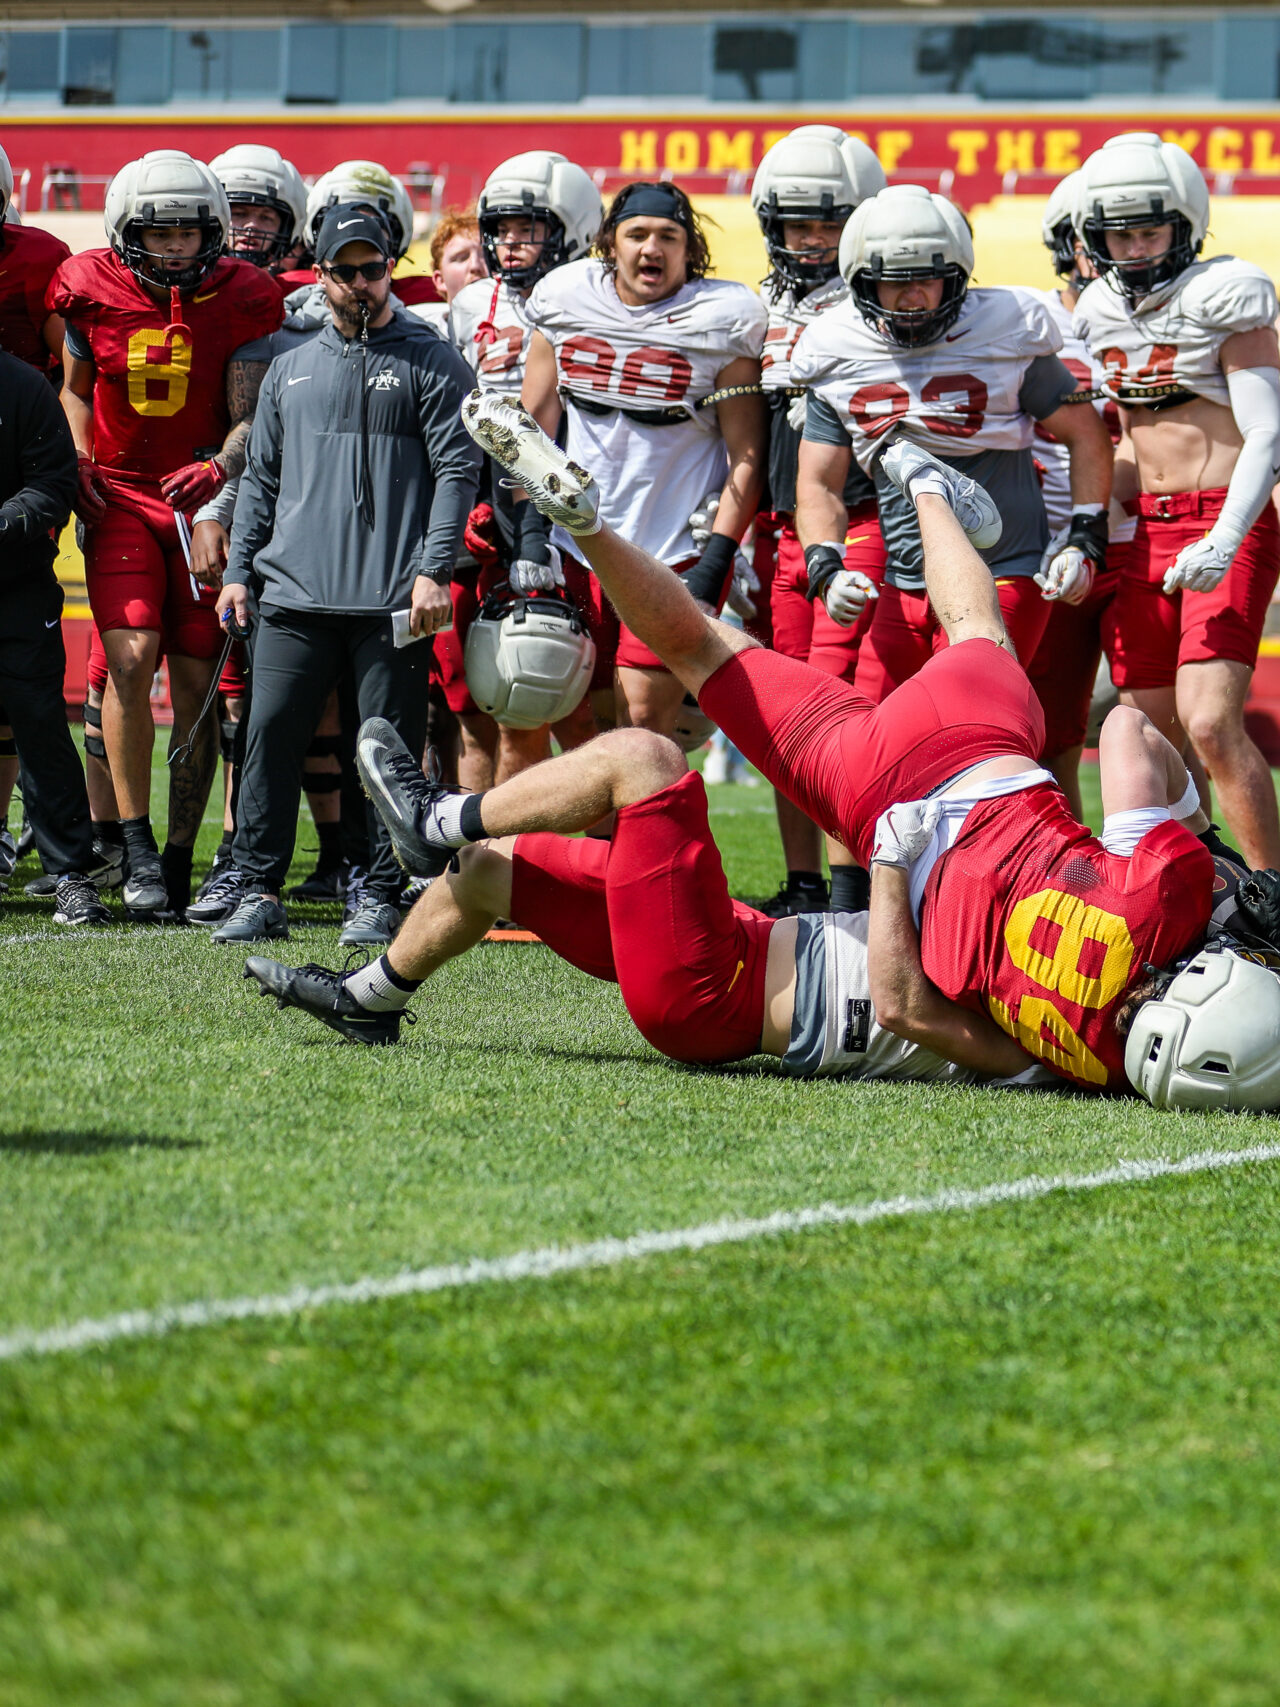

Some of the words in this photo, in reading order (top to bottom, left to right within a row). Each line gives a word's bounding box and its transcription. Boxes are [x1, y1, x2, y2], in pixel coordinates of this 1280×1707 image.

[620, 129, 791, 175] HOM
[947, 129, 1082, 176] THE
[127, 328, 193, 417] 8
